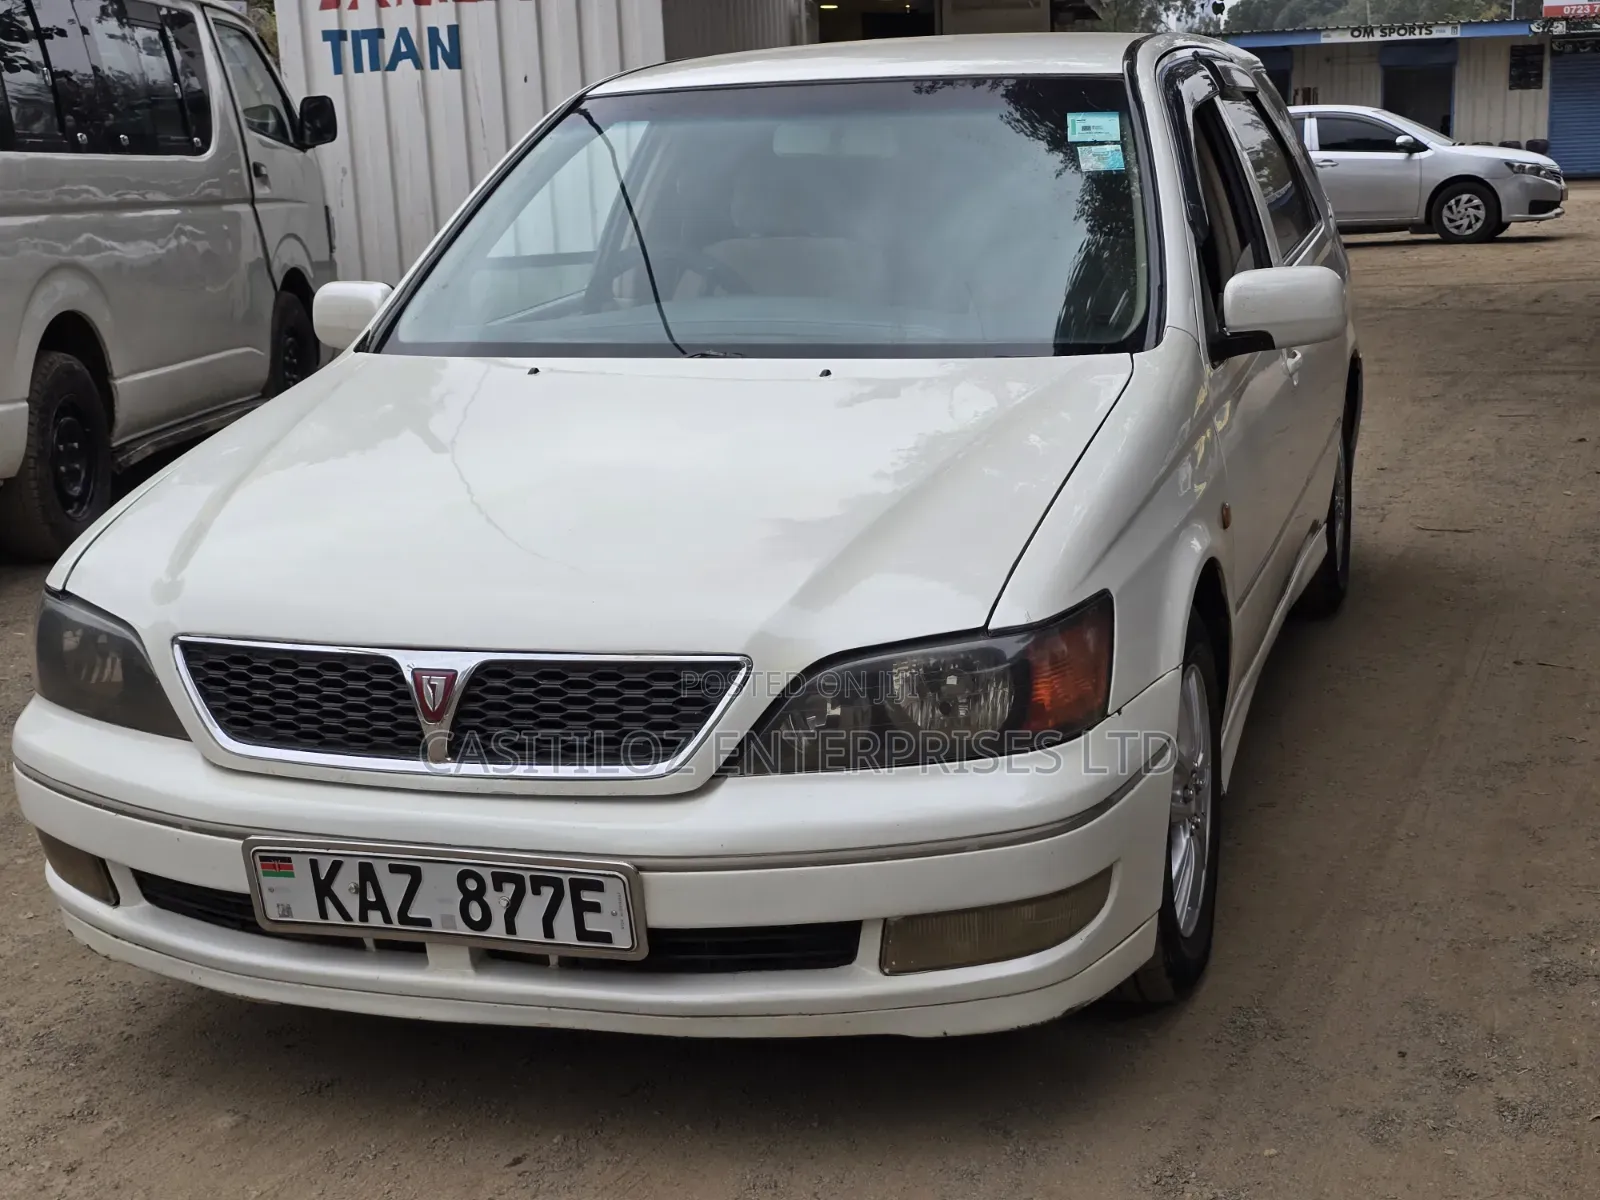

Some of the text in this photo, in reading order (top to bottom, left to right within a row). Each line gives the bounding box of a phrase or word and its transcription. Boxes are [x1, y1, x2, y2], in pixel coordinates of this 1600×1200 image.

[1563, 5, 1590, 14] 0723
[1350, 26, 1375, 39] OM
[1379, 25, 1433, 38] SPORTS
[321, 24, 462, 75] TITAN
[309, 858, 432, 927] KAZ
[456, 868, 613, 943] 877E
